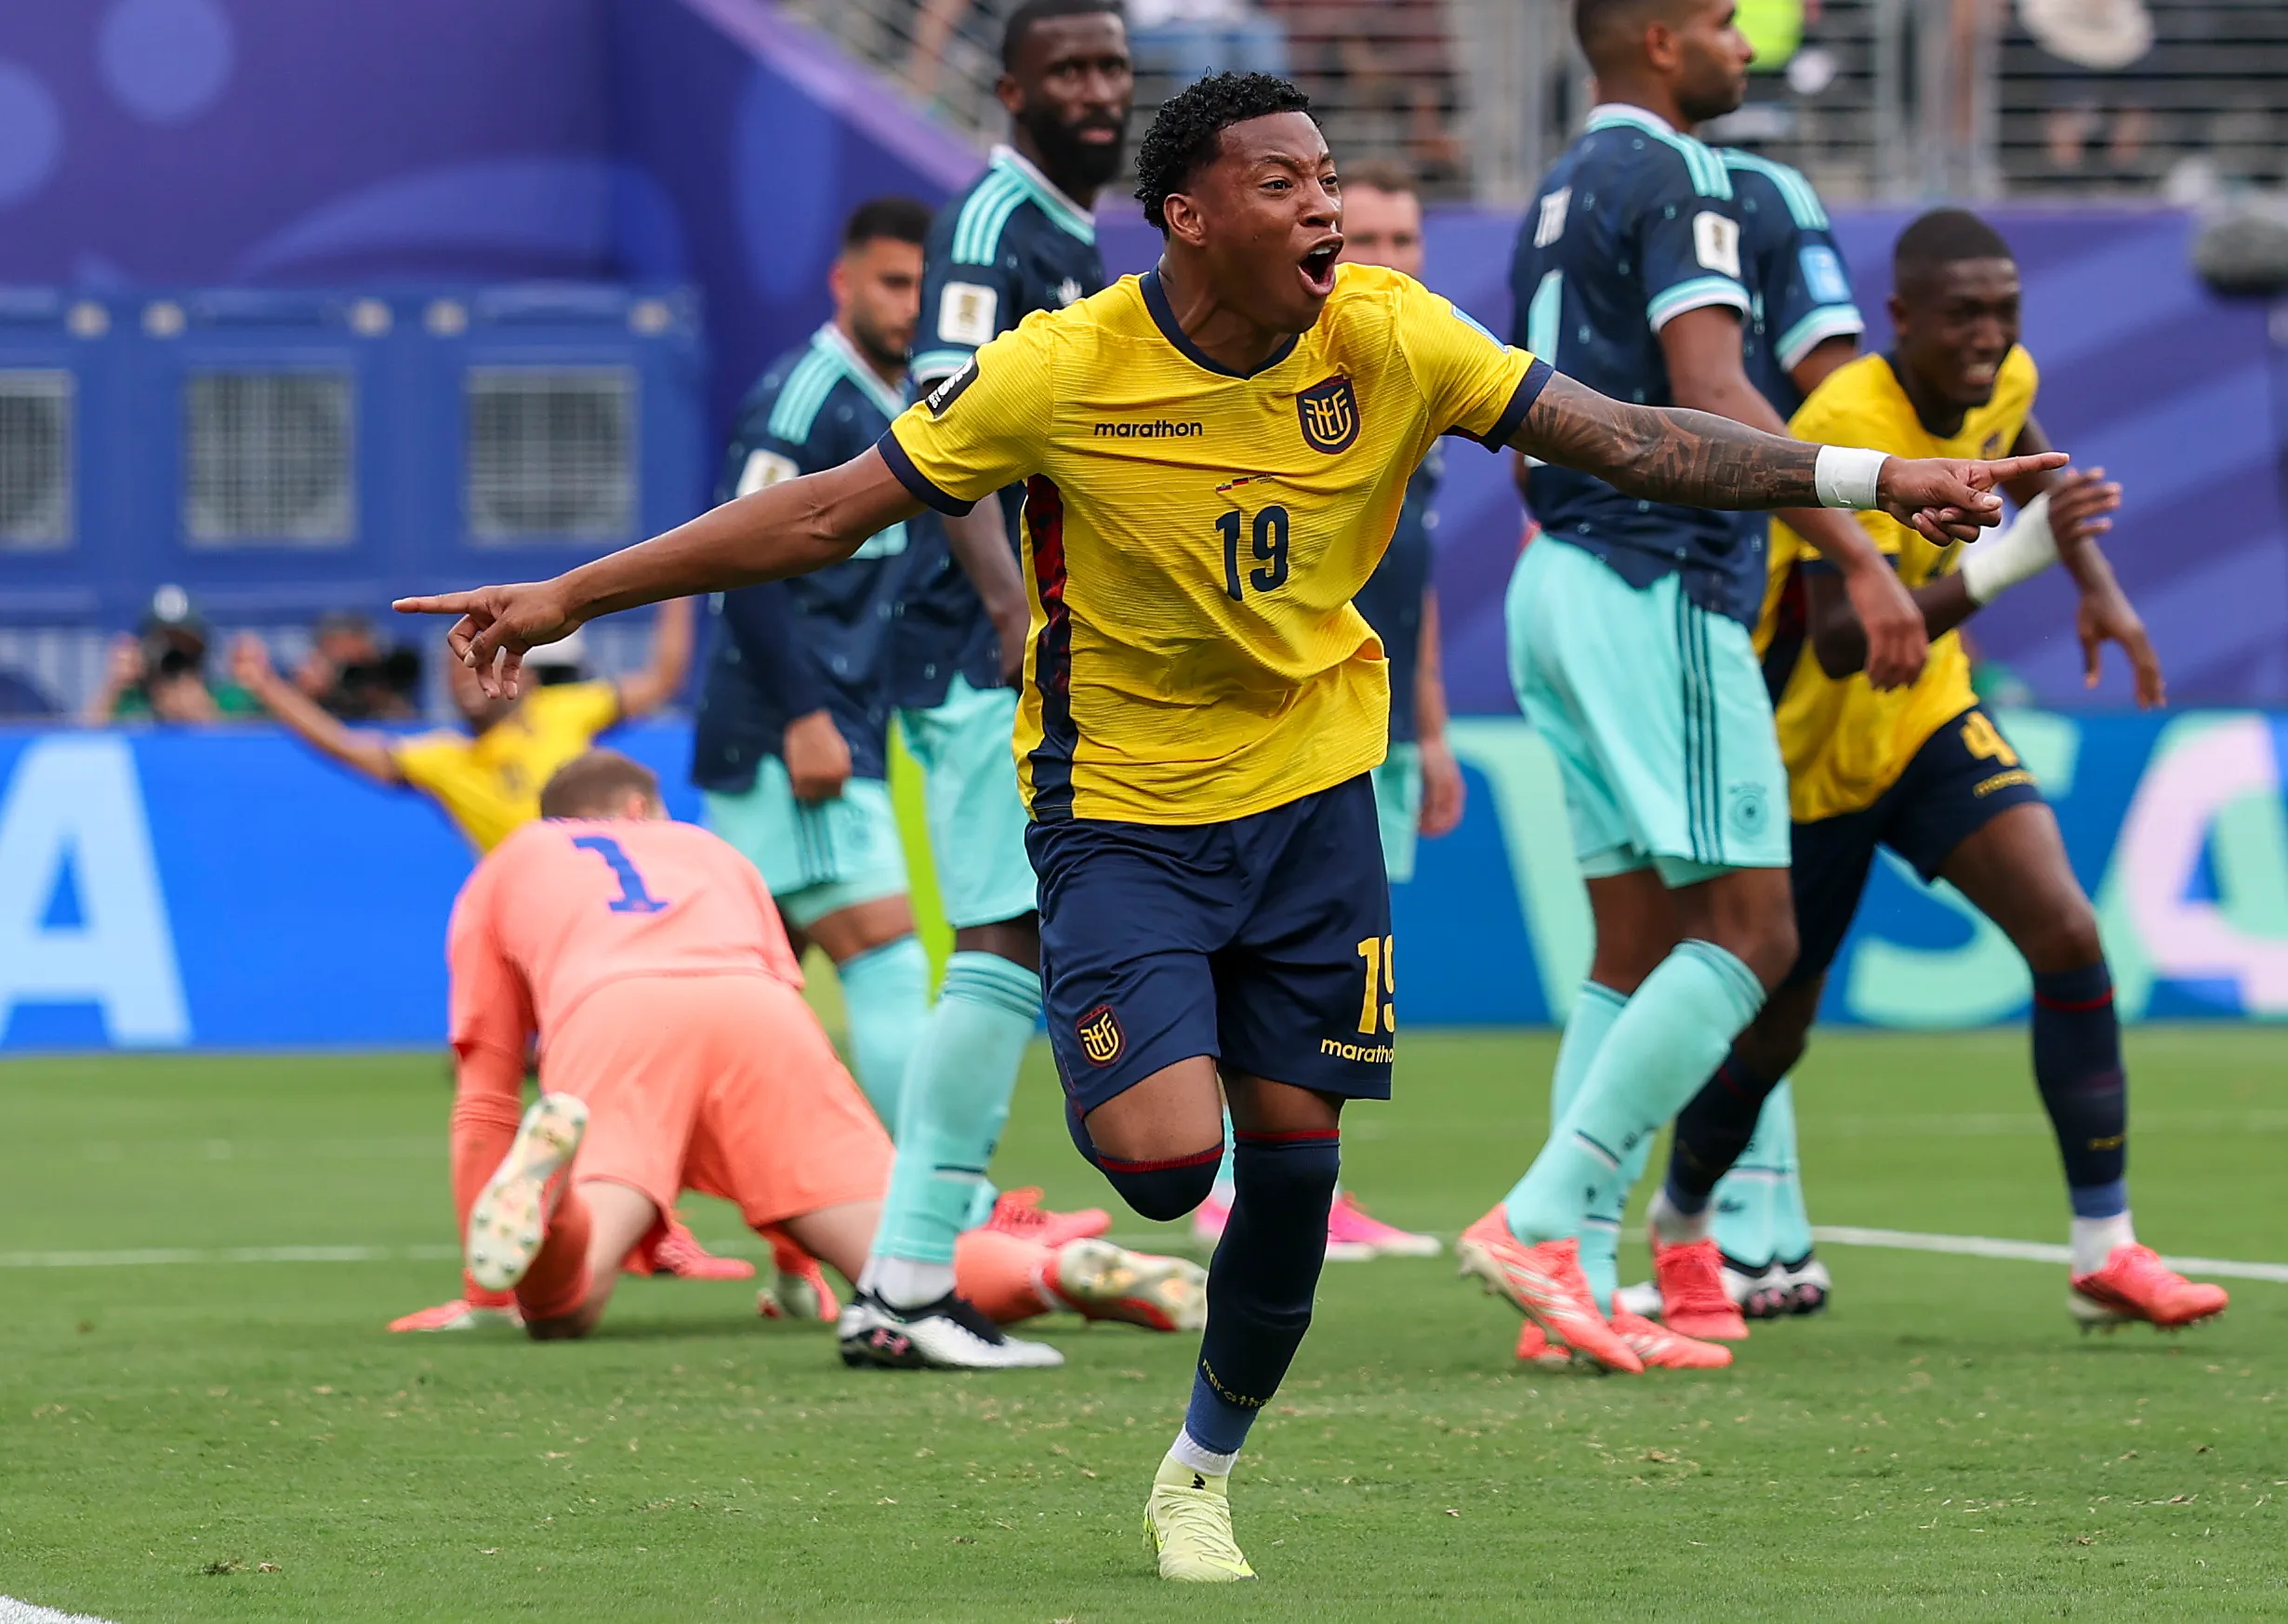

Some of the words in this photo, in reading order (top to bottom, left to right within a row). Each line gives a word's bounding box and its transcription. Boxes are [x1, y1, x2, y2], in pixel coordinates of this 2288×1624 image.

[1093, 420, 1203, 438] marathon
[1215, 505, 1289, 601] 19
[1958, 711, 2020, 768] 4
[569, 835, 670, 914] 1
